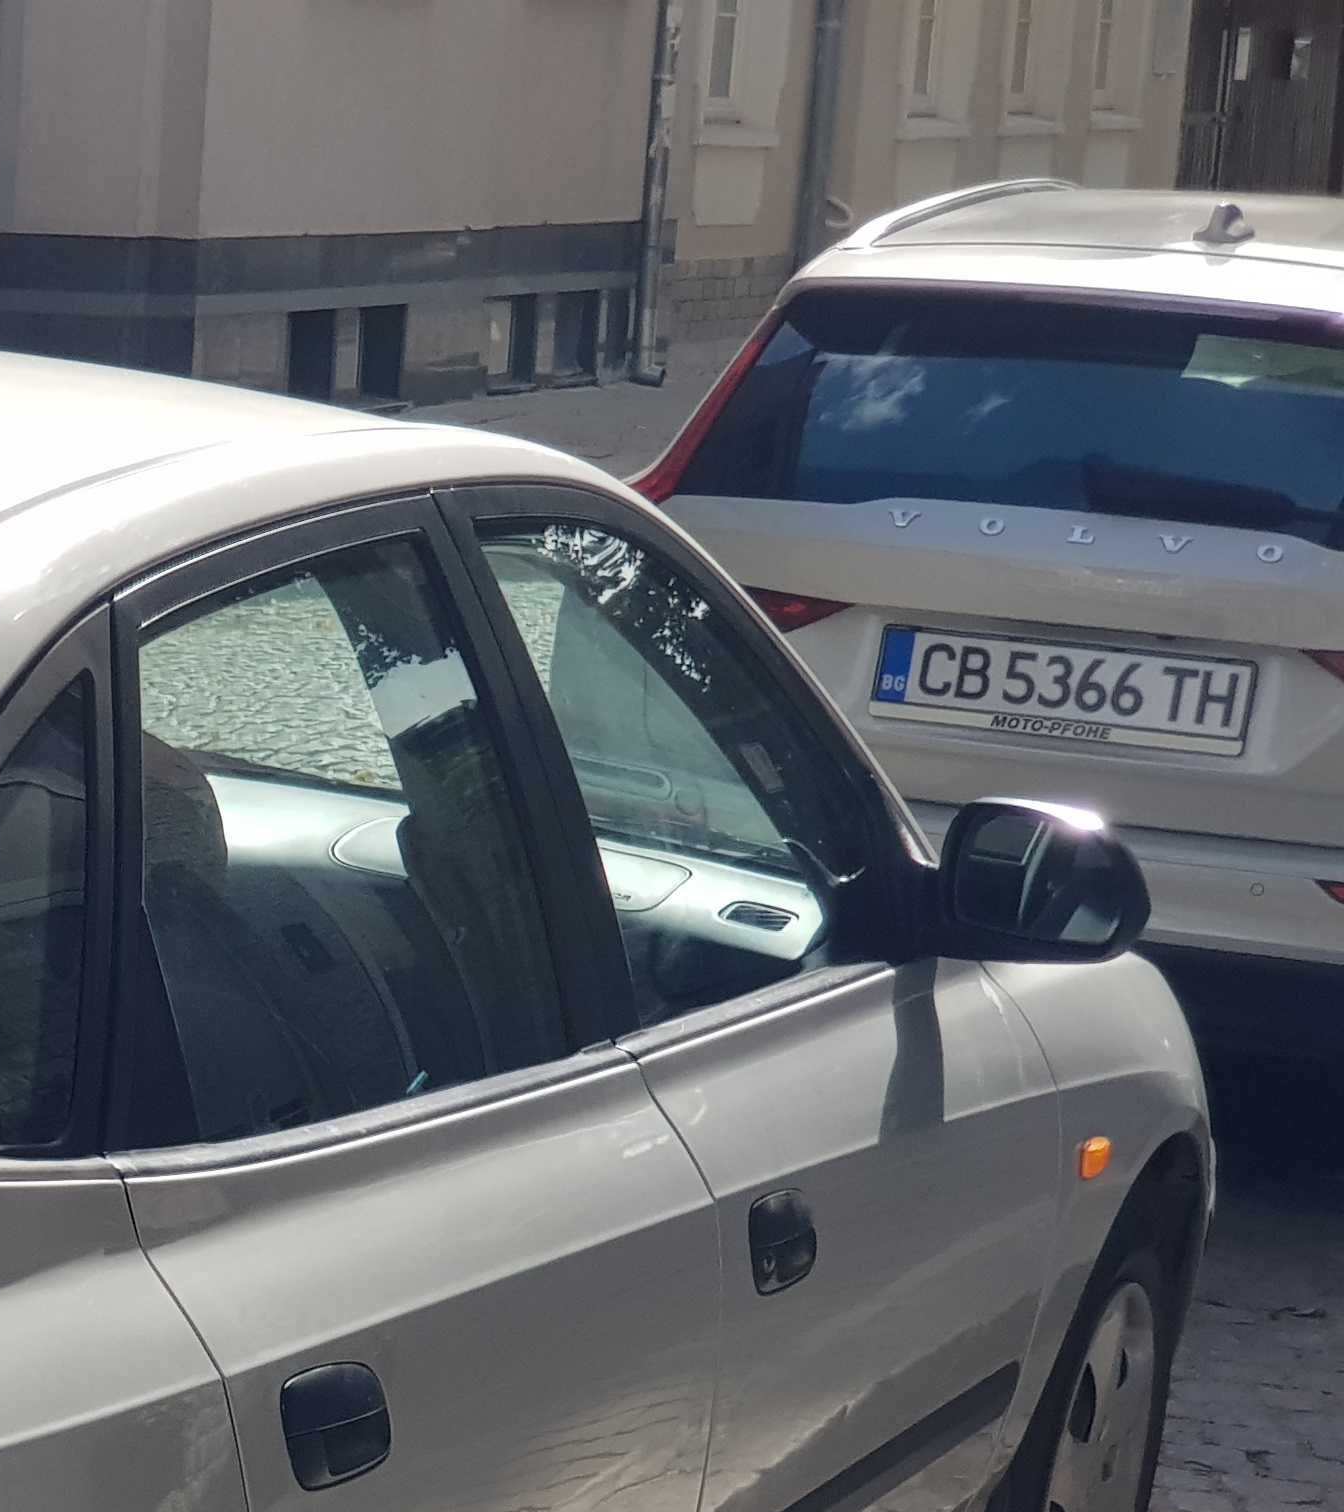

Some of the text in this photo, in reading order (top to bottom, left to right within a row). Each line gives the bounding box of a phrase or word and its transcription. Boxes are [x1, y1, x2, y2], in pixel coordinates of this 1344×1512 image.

[889, 508, 1284, 564] VOLVO
[881, 674, 907, 693] BG
[918, 643, 1241, 728] CB 5366 TH
[990, 715, 1112, 741] MOTO-PFOHE
